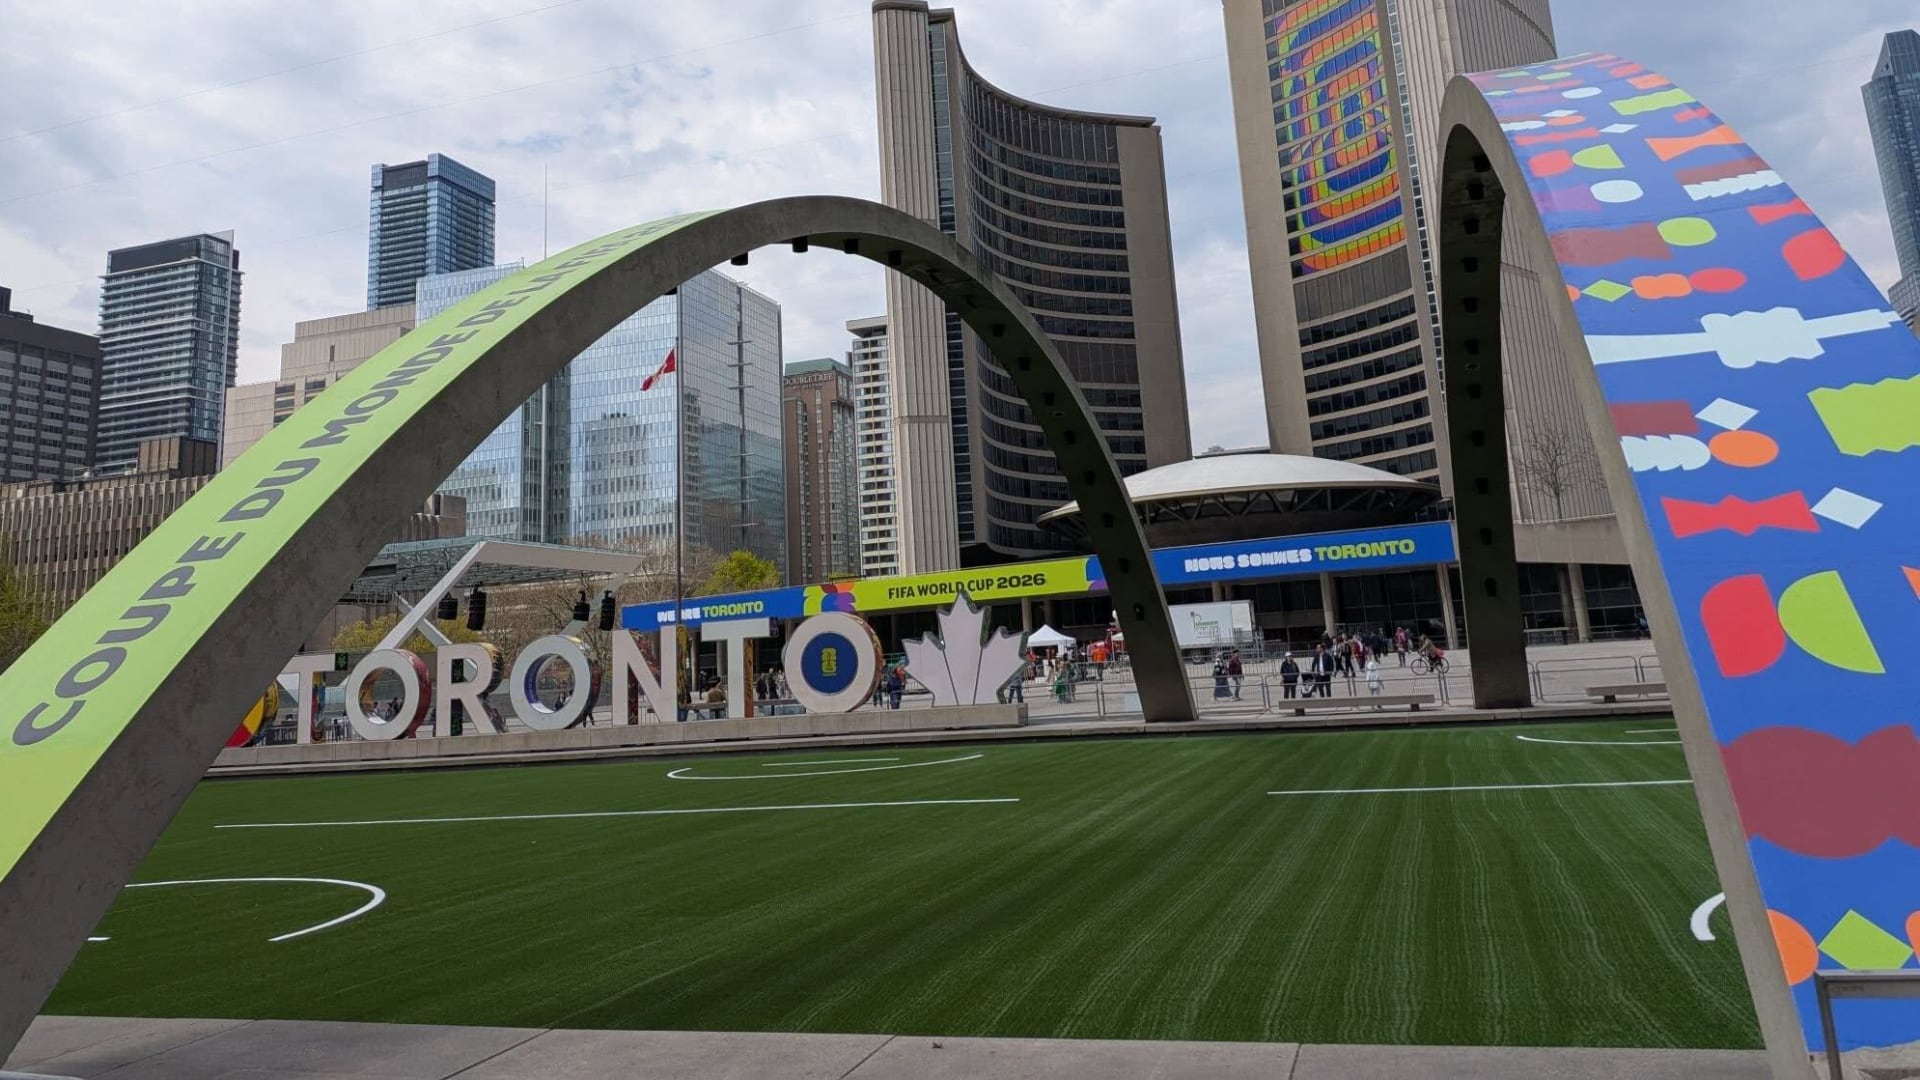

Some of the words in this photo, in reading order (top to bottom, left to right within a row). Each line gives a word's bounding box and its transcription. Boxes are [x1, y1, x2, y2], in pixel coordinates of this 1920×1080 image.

[12, 531, 246, 746] COUPE
[217, 457, 321, 523] DU
[298, 328, 481, 450] MONDE
[455, 295, 531, 328] DE
[506, 266, 582, 296] LA
[1184, 555, 1235, 573] NOUS
[1237, 548, 1312, 568] SOMMES
[1314, 538, 1416, 561] TORONTO
[888, 586, 915, 600] FIFA
[917, 581, 965, 597] WORLD
[967, 578, 994, 592] CUP
[997, 573, 1046, 589] 2026
[657, 609, 676, 623] WE
[702, 600, 764, 618] TORONTO
[278, 612, 880, 745] TORONTO
